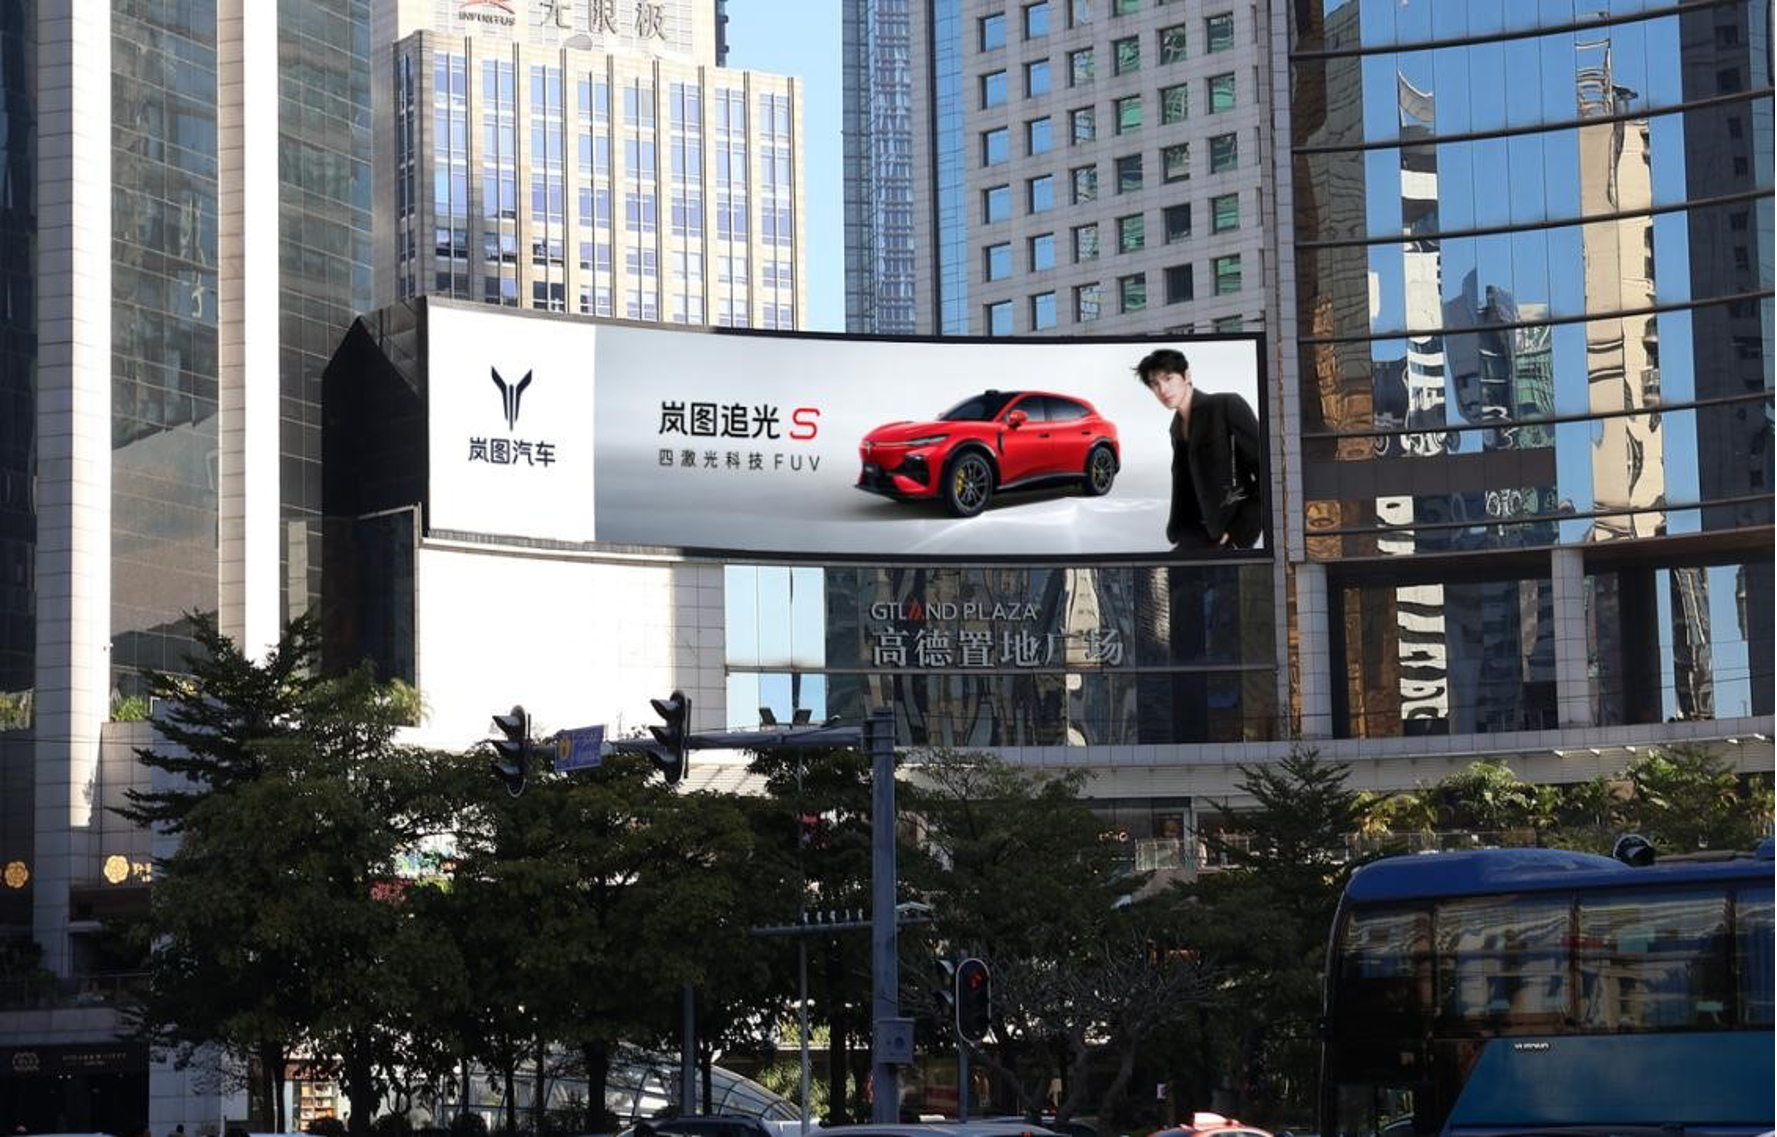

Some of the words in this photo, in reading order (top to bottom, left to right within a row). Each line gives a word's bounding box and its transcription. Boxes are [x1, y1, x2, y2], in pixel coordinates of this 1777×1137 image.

[539, 0, 667, 41] 无限极
[658, 401, 781, 440] 岚图追光
[789, 407, 821, 440] S
[468, 436, 556, 467] 岚图汽车
[659, 448, 764, 471] 四激光科技
[774, 454, 821, 472] FUV
[871, 600, 958, 621] GTLAND
[963, 602, 1038, 620] PLAZA
[871, 626, 1124, 667] 高德置地广场
